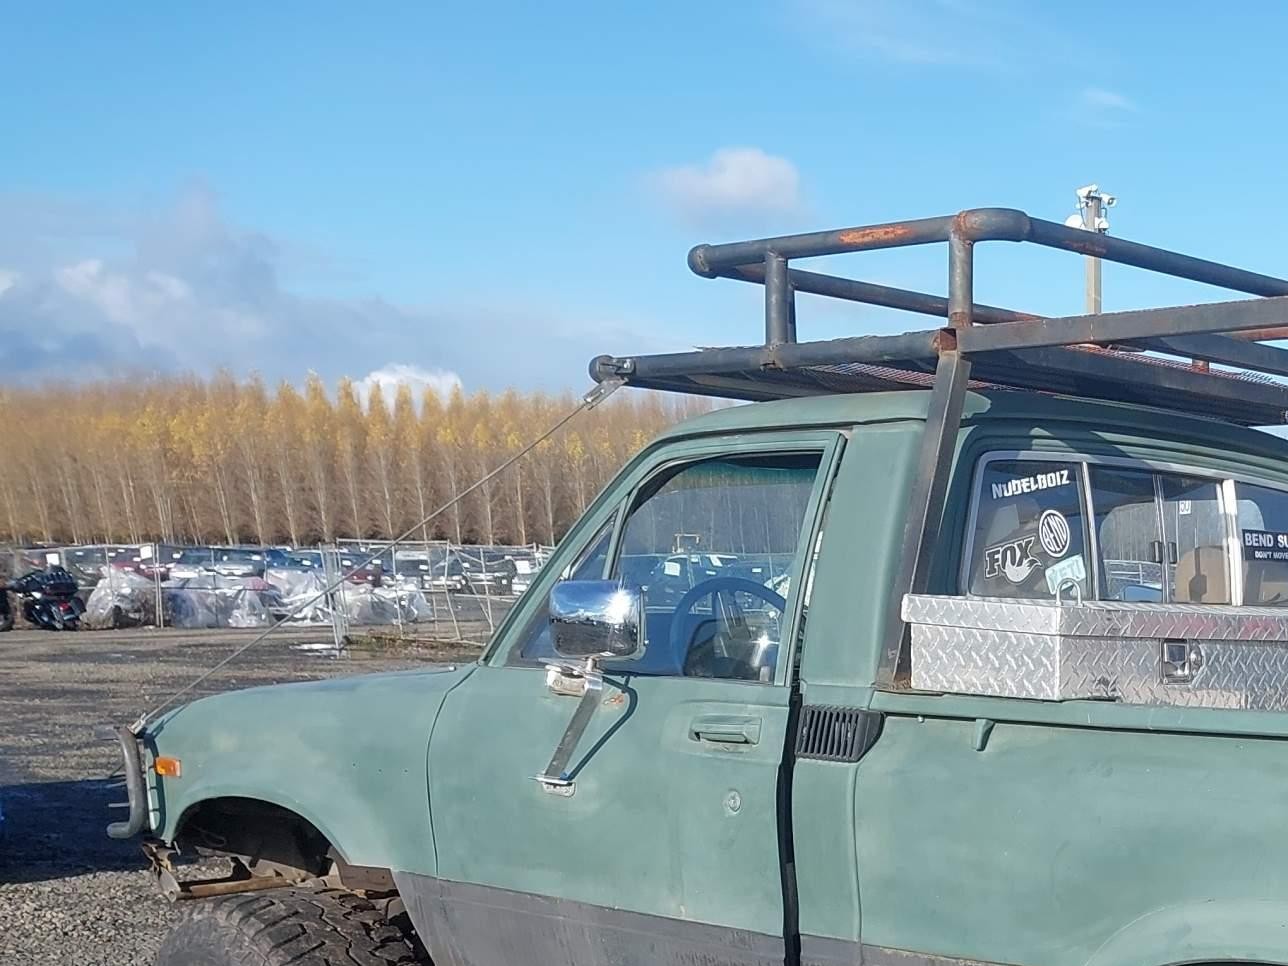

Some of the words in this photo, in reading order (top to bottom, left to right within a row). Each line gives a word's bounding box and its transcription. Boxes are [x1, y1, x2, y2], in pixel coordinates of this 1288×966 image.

[1244, 532, 1274, 547] BEND
[985, 535, 1036, 579] FOX
[1273, 551, 1288, 560] MOVE
